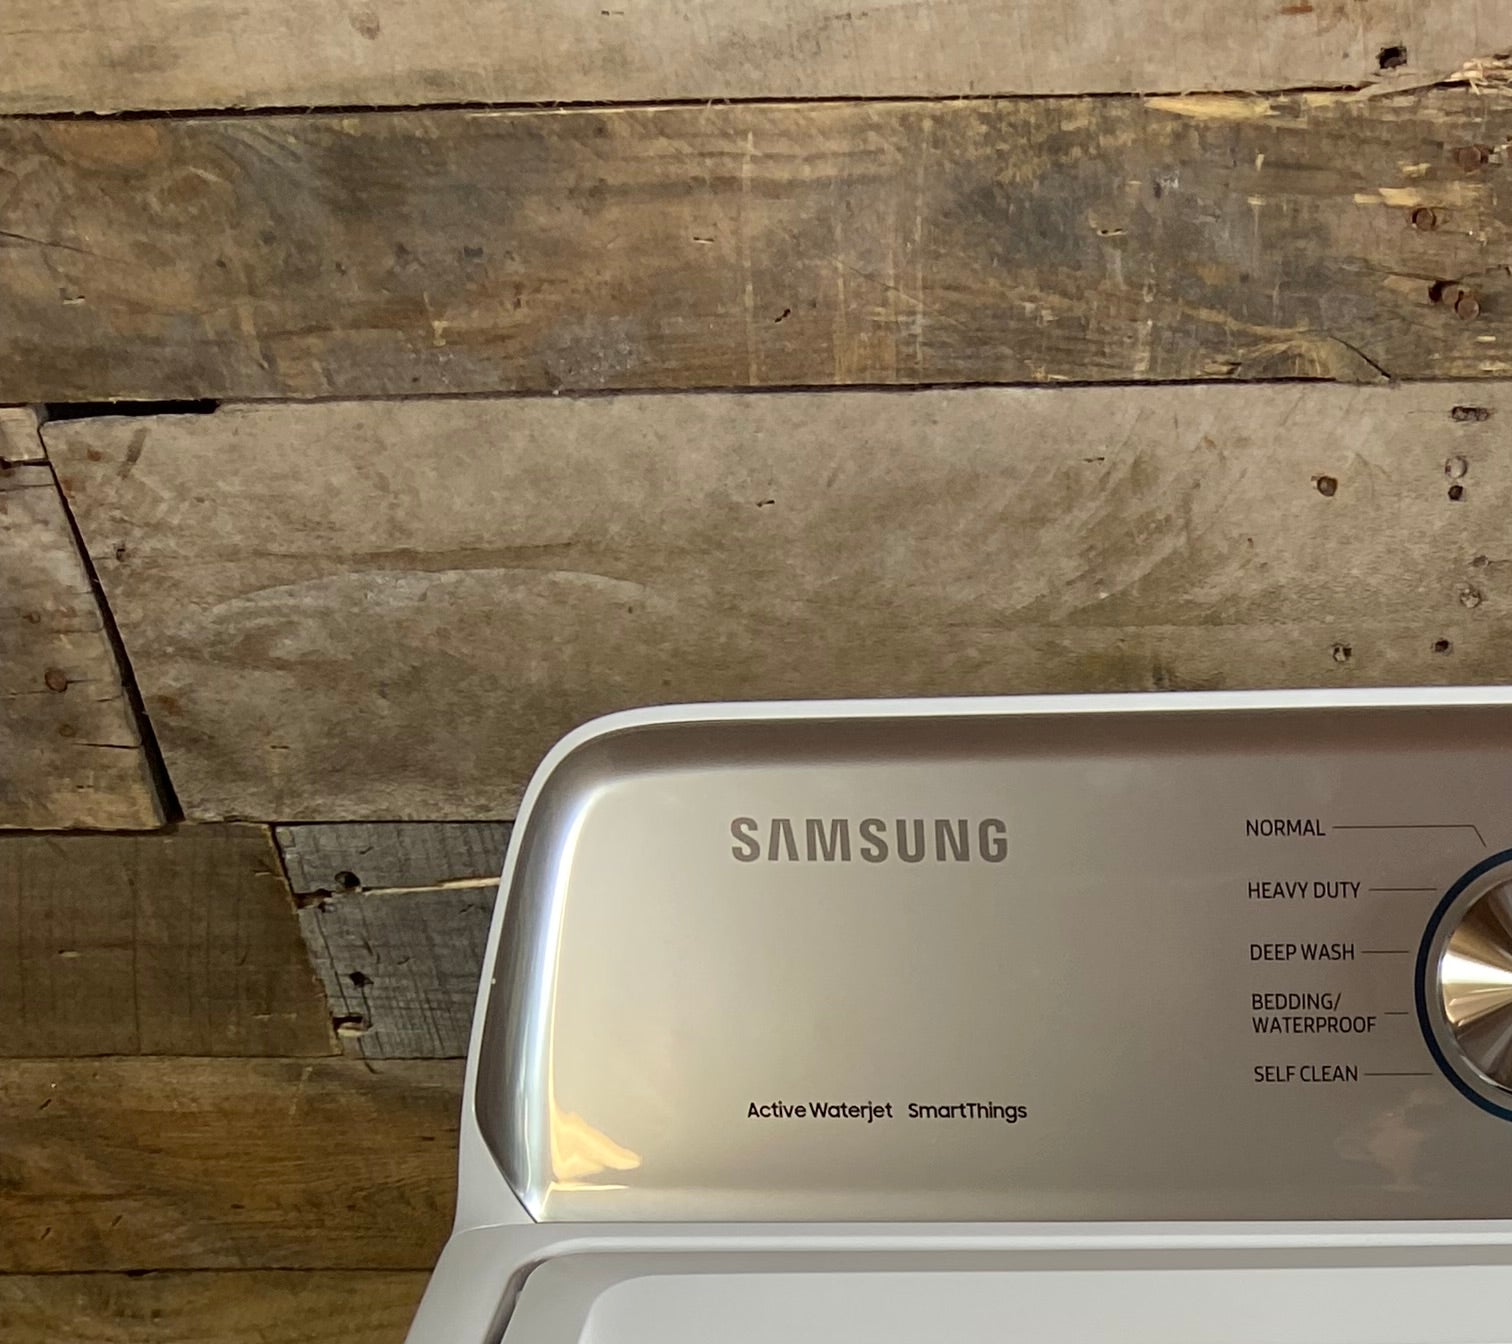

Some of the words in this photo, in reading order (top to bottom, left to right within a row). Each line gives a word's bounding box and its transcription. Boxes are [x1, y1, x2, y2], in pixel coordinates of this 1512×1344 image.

[1246, 819, 1326, 837] NORMAL
[730, 817, 1008, 863] SAMSUNG
[1248, 882, 1308, 899] HEAVY
[1313, 882, 1361, 899] DUTY
[1250, 944, 1296, 960] DEEP
[1300, 944, 1355, 960] WASH
[1251, 992, 1341, 1010] BEDDING/
[1252, 1016, 1377, 1033] WATERPROOF
[1254, 1066, 1296, 1082] SELF
[1300, 1065, 1358, 1082] CLEAN
[748, 1102, 806, 1118] Active
[809, 1102, 893, 1123] Waterjet
[908, 1102, 1027, 1124] SmartThings
